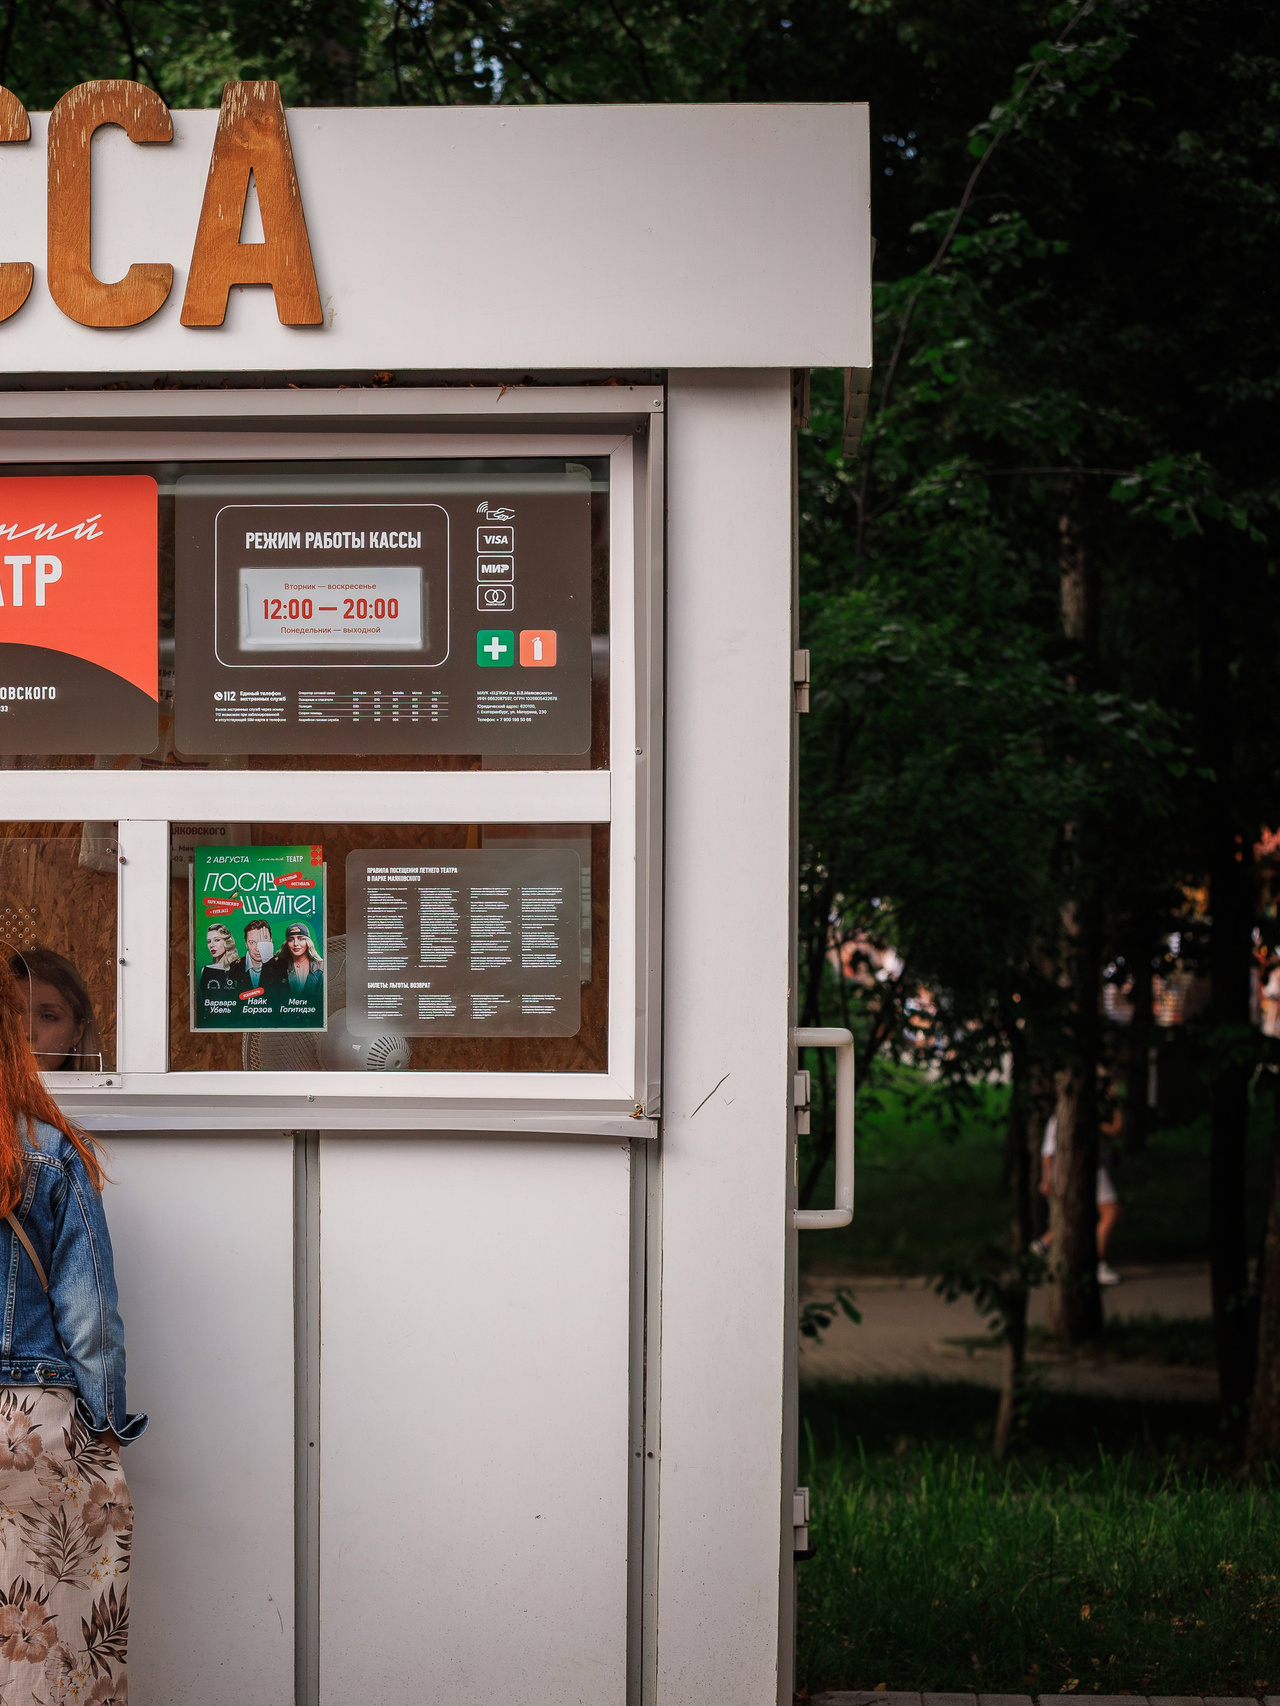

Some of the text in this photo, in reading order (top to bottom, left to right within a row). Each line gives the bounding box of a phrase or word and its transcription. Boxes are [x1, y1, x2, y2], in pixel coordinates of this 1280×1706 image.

[246, 532, 421, 549] РЕЖИМ РАБОТЫ КАССЫ
[483, 535, 508, 544] VISA
[481, 564, 509, 574] МИР
[284, 583, 316, 591] Вторник
[328, 583, 376, 591] воскресенье
[264, 599, 312, 619] 12:00
[343, 598, 398, 619] 20:00
[343, 626, 380, 634] выходной
[224, 691, 236, 701] 112
[172, 827, 226, 835] ЯКОВСКОГО
[204, 999, 237, 1007] Варвара
[210, 1006, 231, 1014] Убель
[242, 1006, 272, 1014] Борзов
